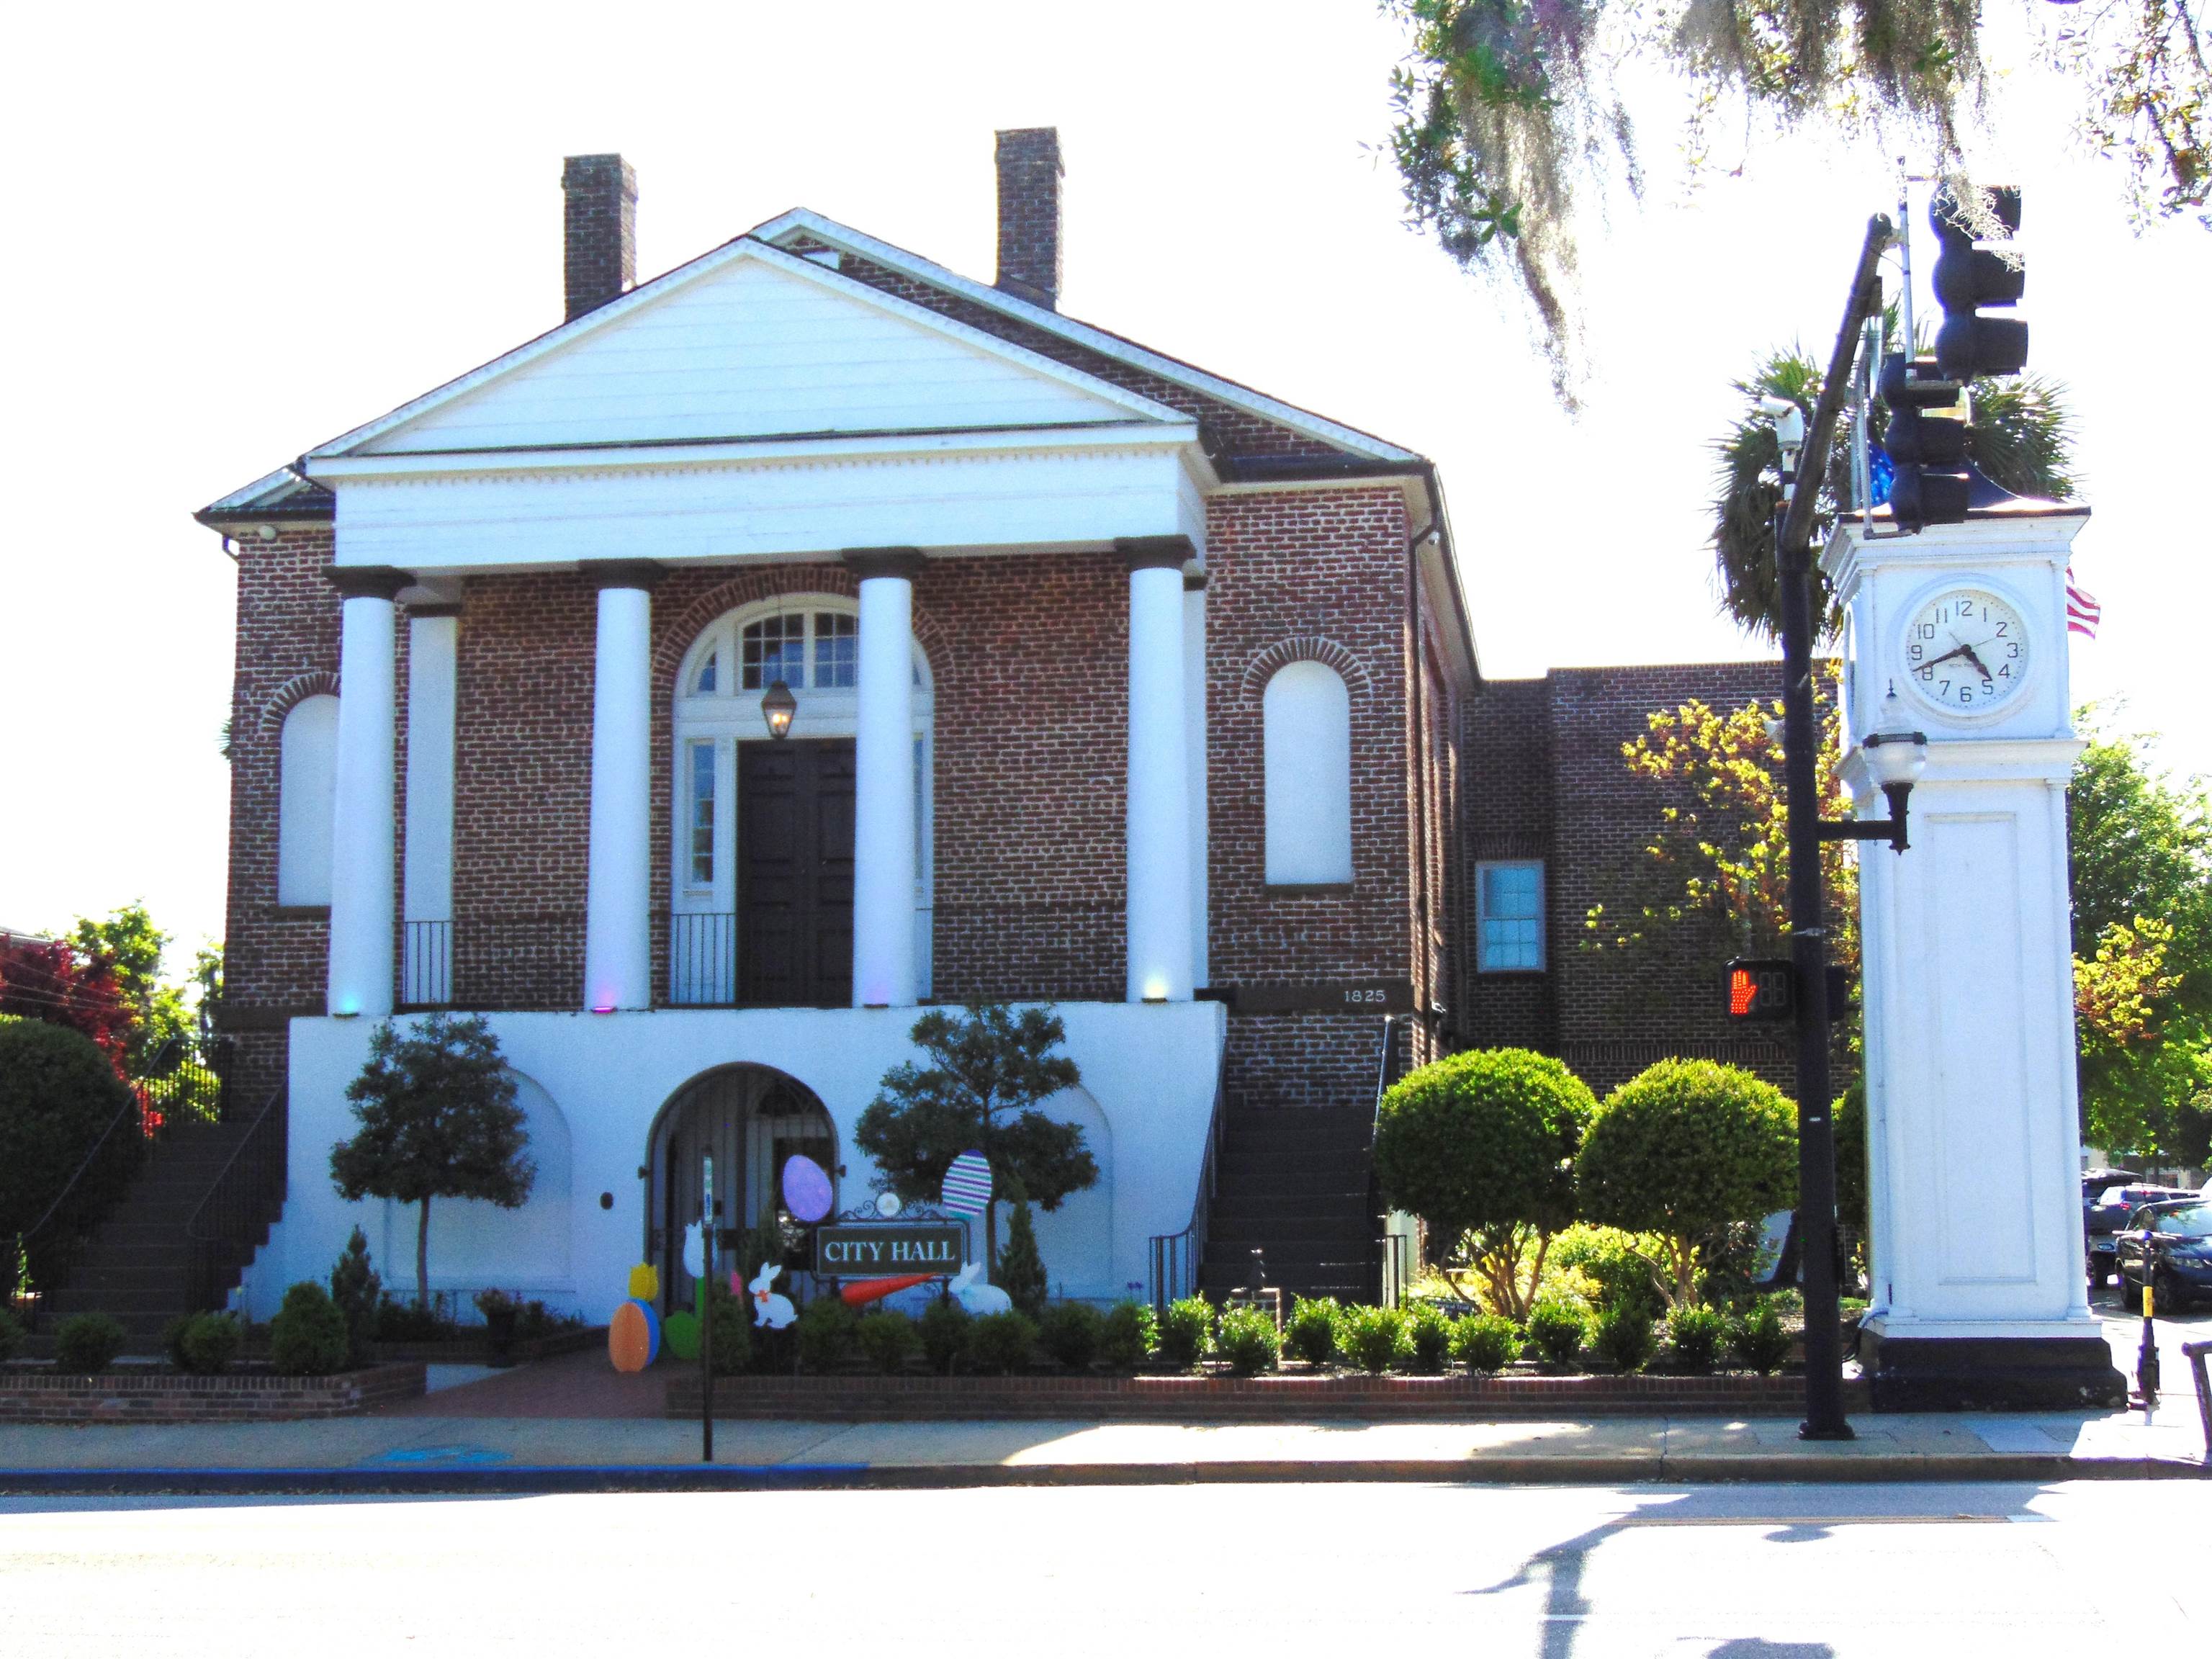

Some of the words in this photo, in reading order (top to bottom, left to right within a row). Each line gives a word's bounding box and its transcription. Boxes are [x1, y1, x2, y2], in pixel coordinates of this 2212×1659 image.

[1936, 608, 1948, 624] 11
[1956, 601, 1973, 616] 12
[1917, 623, 1935, 639] 10
[1995, 621, 2008, 637] 2
[1911, 644, 1923, 660] 9
[2007, 642, 2019, 658] 3
[1922, 665, 1933, 681] 8
[1998, 663, 2010, 679] 4
[1938, 680, 1951, 696] 7
[1960, 686, 1972, 702] 6
[1981, 679, 1993, 696] 5
[1344, 990, 1385, 1002] 1825
[824, 1241, 884, 1262] CITY
[891, 1241, 956, 1261] HALL
